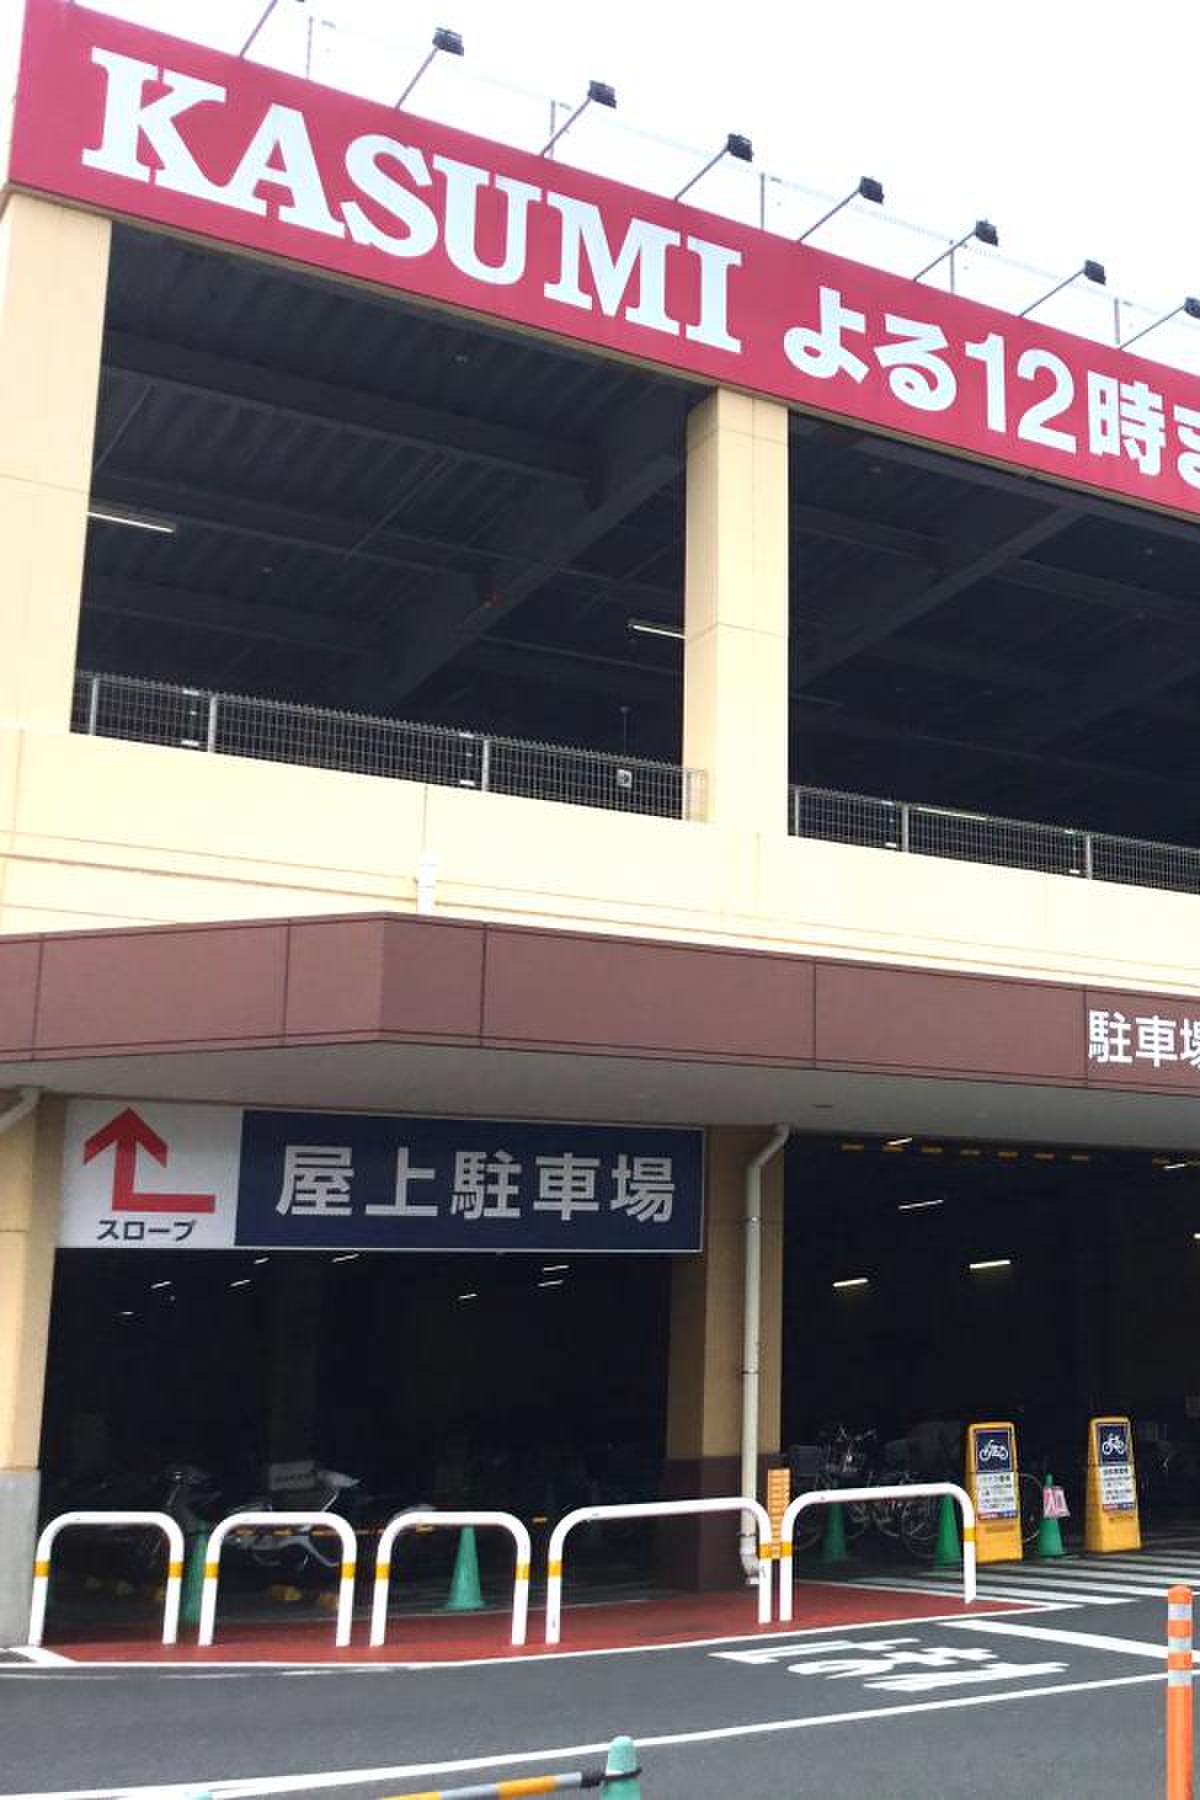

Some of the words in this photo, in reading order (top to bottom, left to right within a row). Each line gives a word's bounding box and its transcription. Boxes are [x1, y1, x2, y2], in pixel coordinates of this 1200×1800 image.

[82, 46, 742, 354] KASUMI
[276, 1145, 675, 1223] 屋上駐車場
[97, 1219, 196, 1242] スロープ
